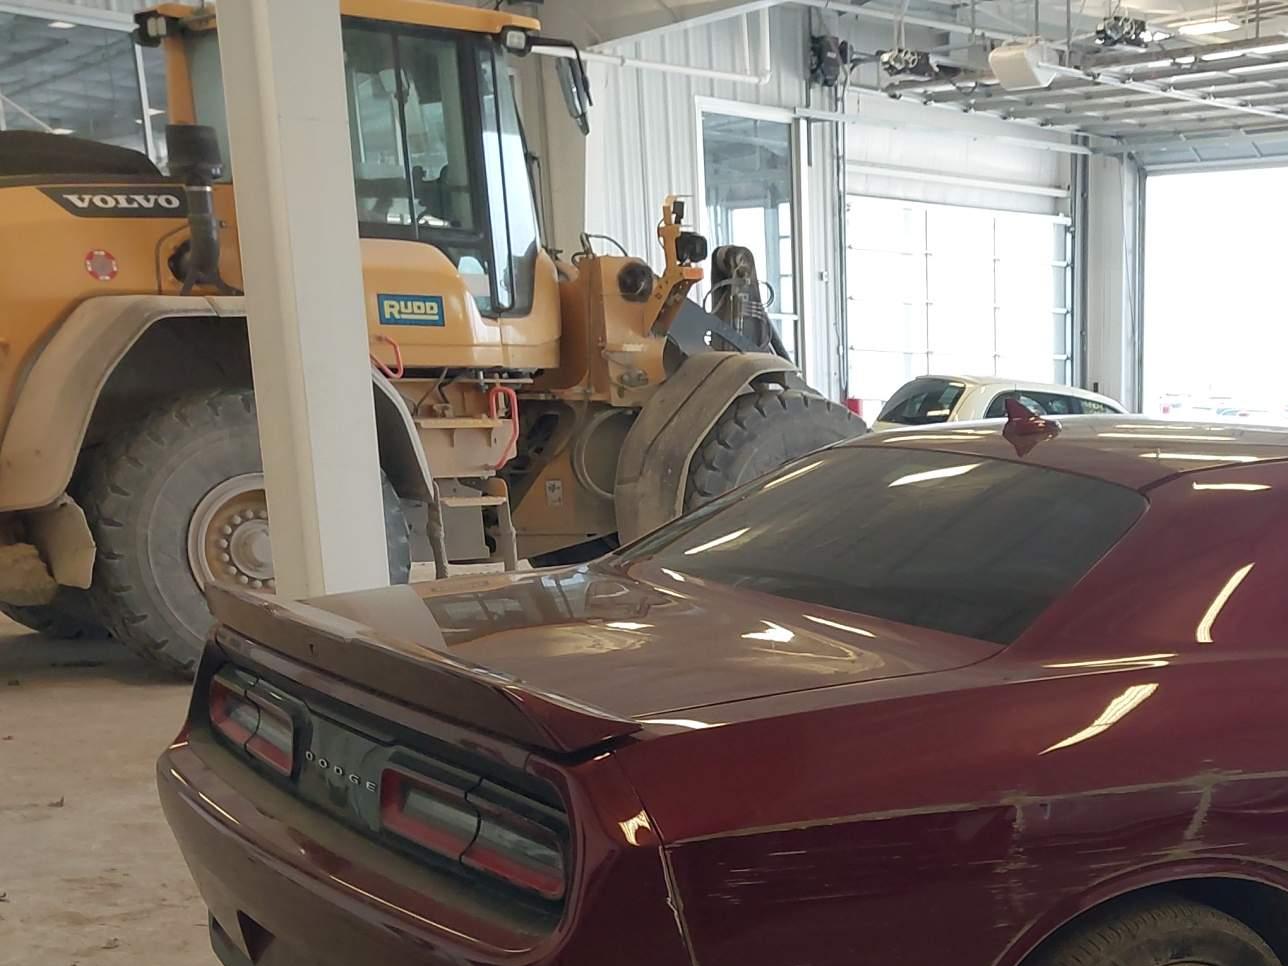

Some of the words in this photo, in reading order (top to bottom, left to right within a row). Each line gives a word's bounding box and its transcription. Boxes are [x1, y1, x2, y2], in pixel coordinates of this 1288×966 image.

[61, 193, 181, 209] VOLVO
[384, 298, 439, 319] RUDD
[305, 750, 377, 793] DODGE
